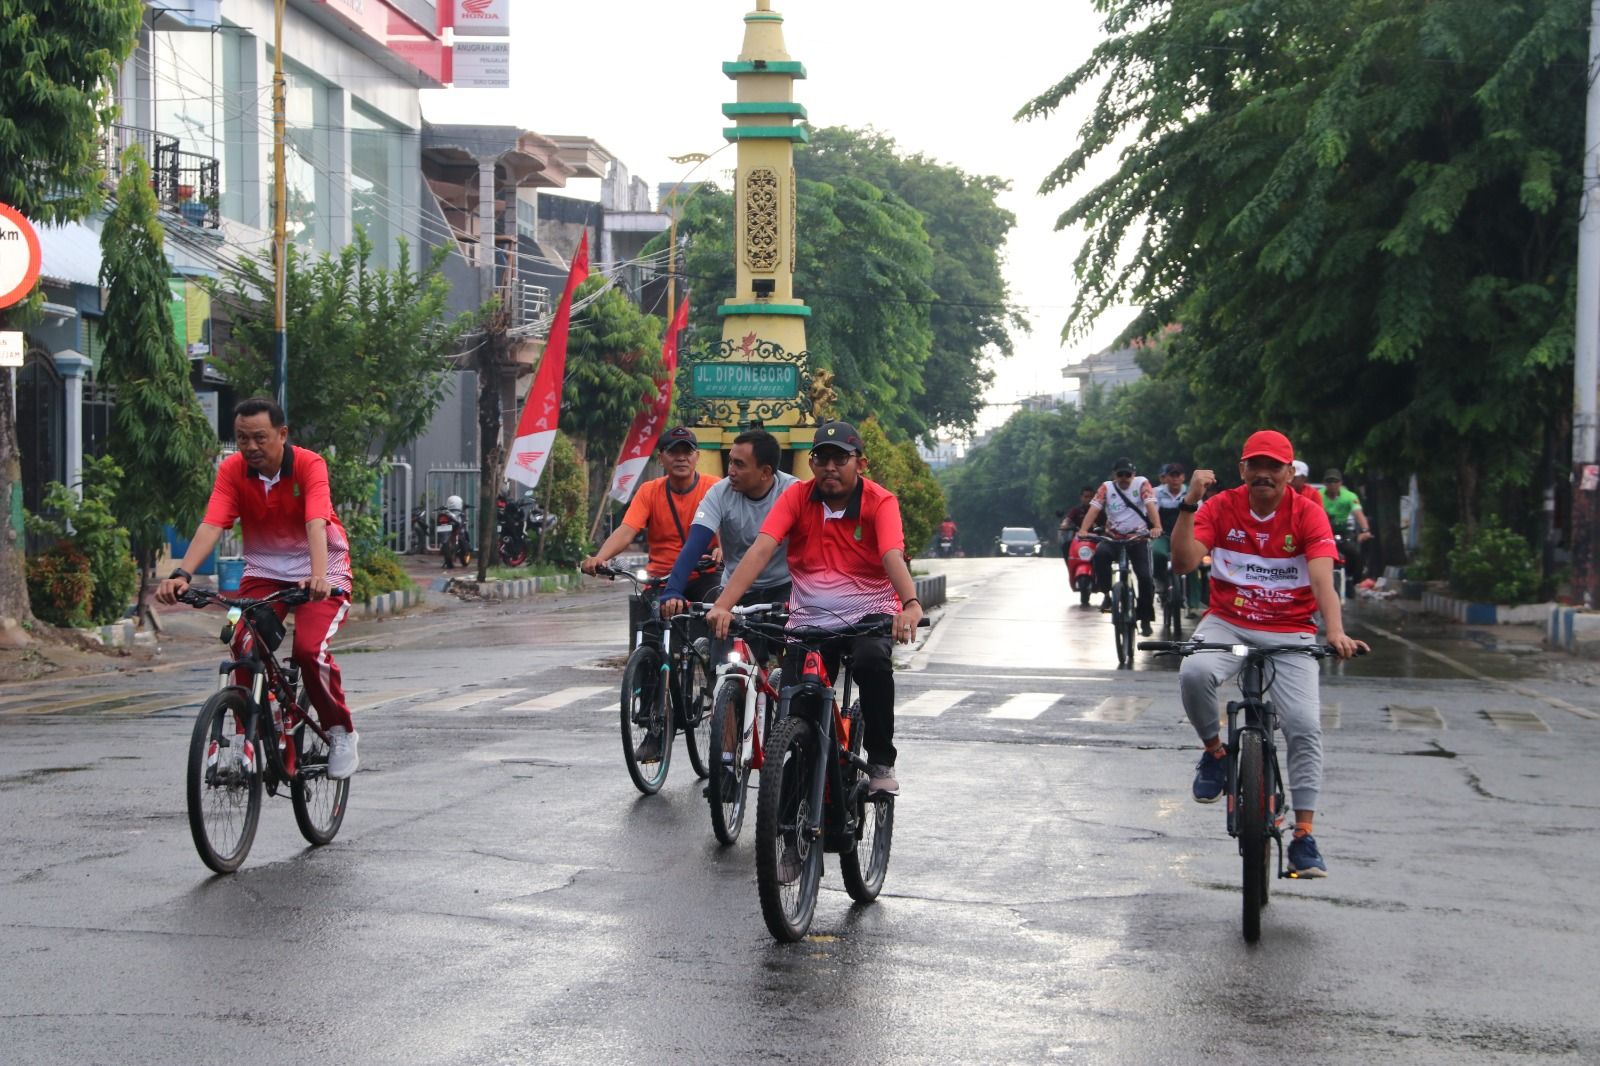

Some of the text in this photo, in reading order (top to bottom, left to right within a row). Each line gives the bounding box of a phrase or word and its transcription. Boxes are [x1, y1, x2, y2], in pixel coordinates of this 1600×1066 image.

[457, 44, 508, 52] ANUGRAH JAYA
[716, 366, 792, 383] DIPONEGORO
